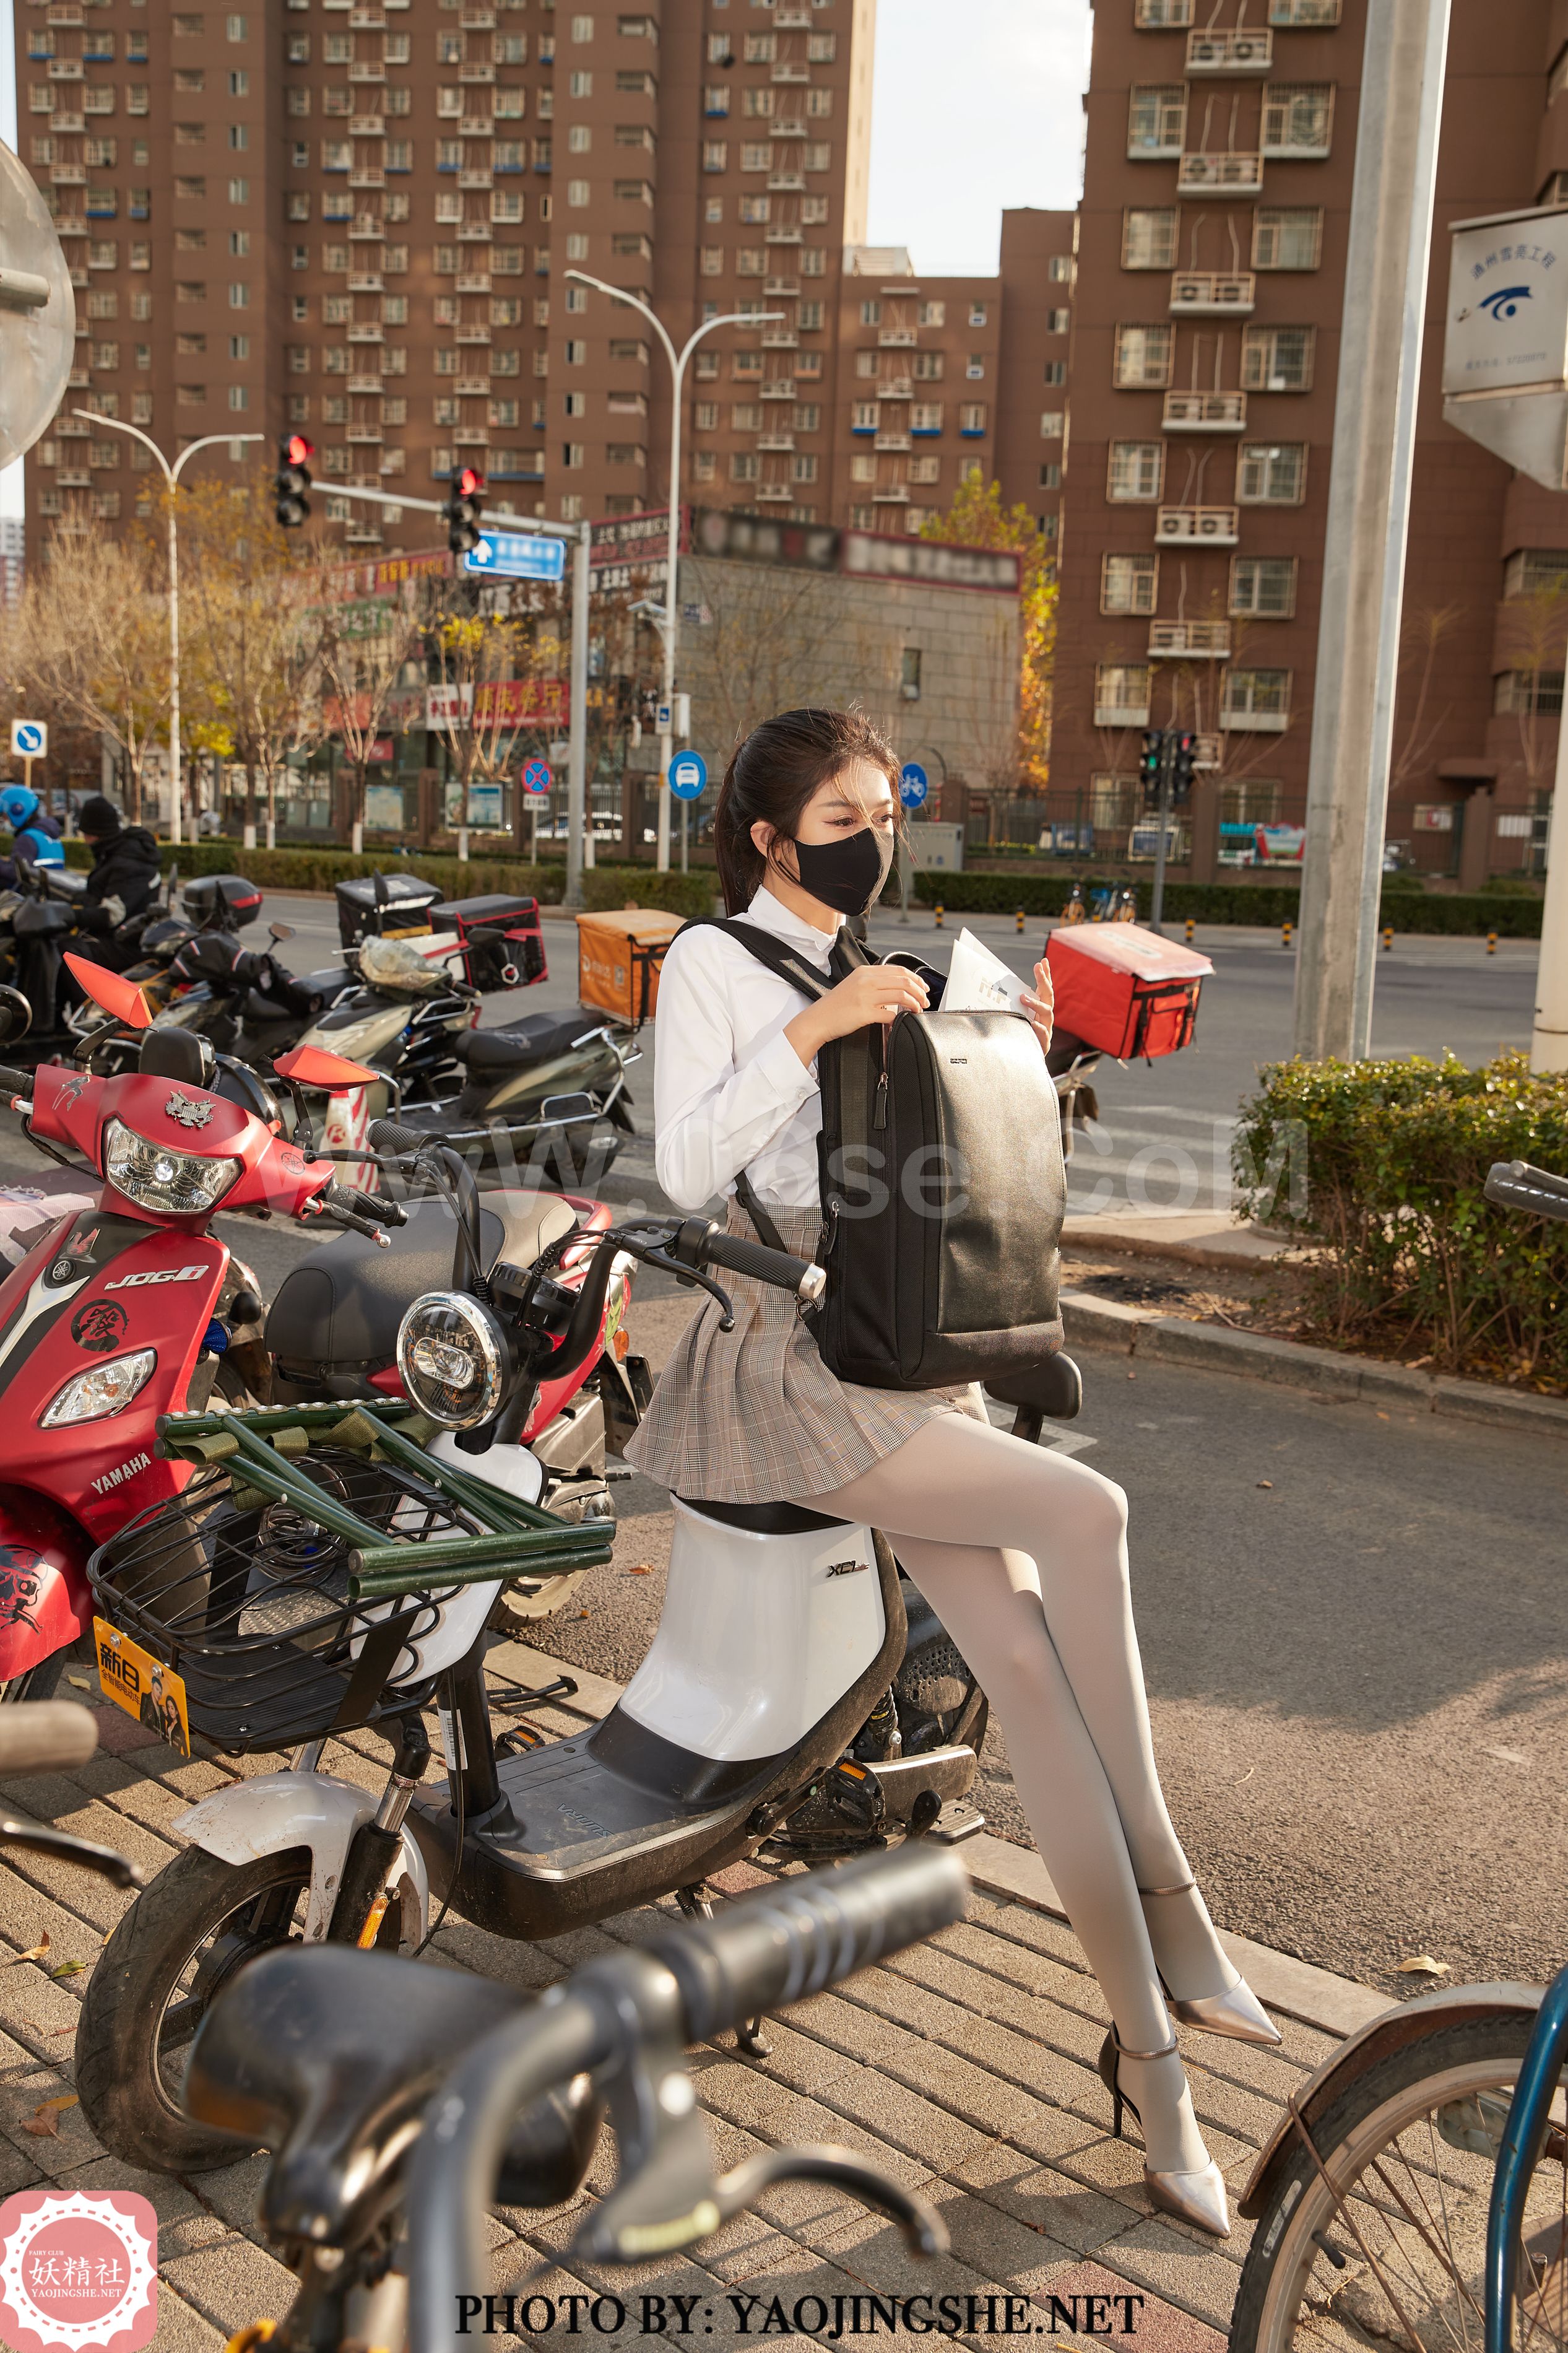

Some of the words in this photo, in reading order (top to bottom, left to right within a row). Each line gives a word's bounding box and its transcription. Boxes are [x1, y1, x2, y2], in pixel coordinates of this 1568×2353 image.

[90, 1452, 152, 1495] YAMAHA
[100, 1642, 139, 1692] 新日
[102, 1669, 141, 1705] 全智能电动车
[557, 1803, 615, 1838] SUNRA
